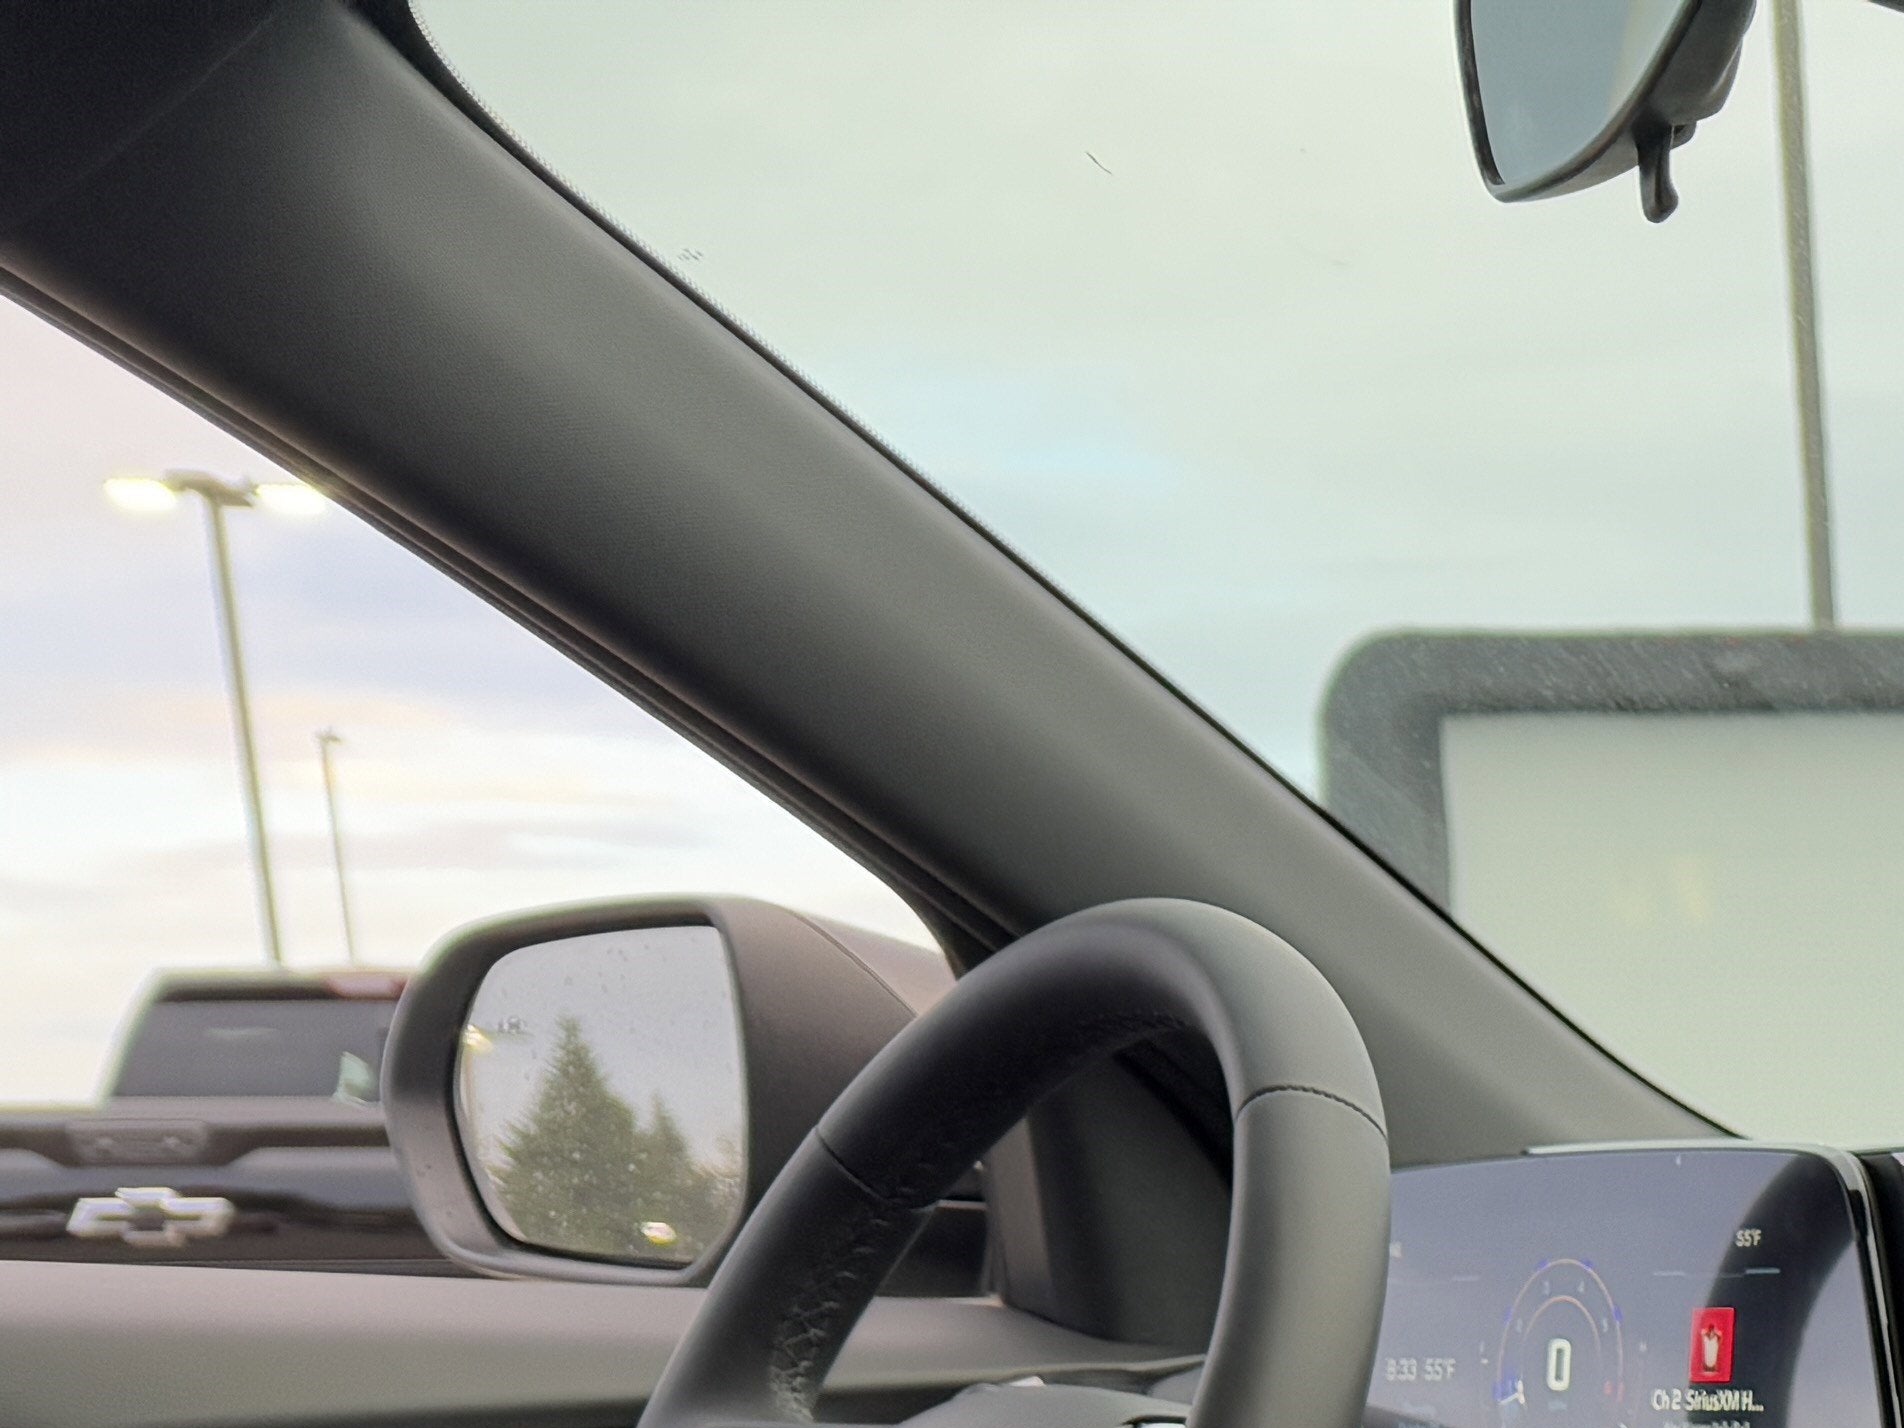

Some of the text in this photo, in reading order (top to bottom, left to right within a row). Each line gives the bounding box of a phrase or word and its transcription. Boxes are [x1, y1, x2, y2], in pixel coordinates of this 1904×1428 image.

[1547, 1338, 1571, 1391] 0
[1652, 1388, 1669, 1410] Ch
[1671, 1388, 1682, 1410] 2
[1685, 1388, 1740, 1411] SiriusXM
